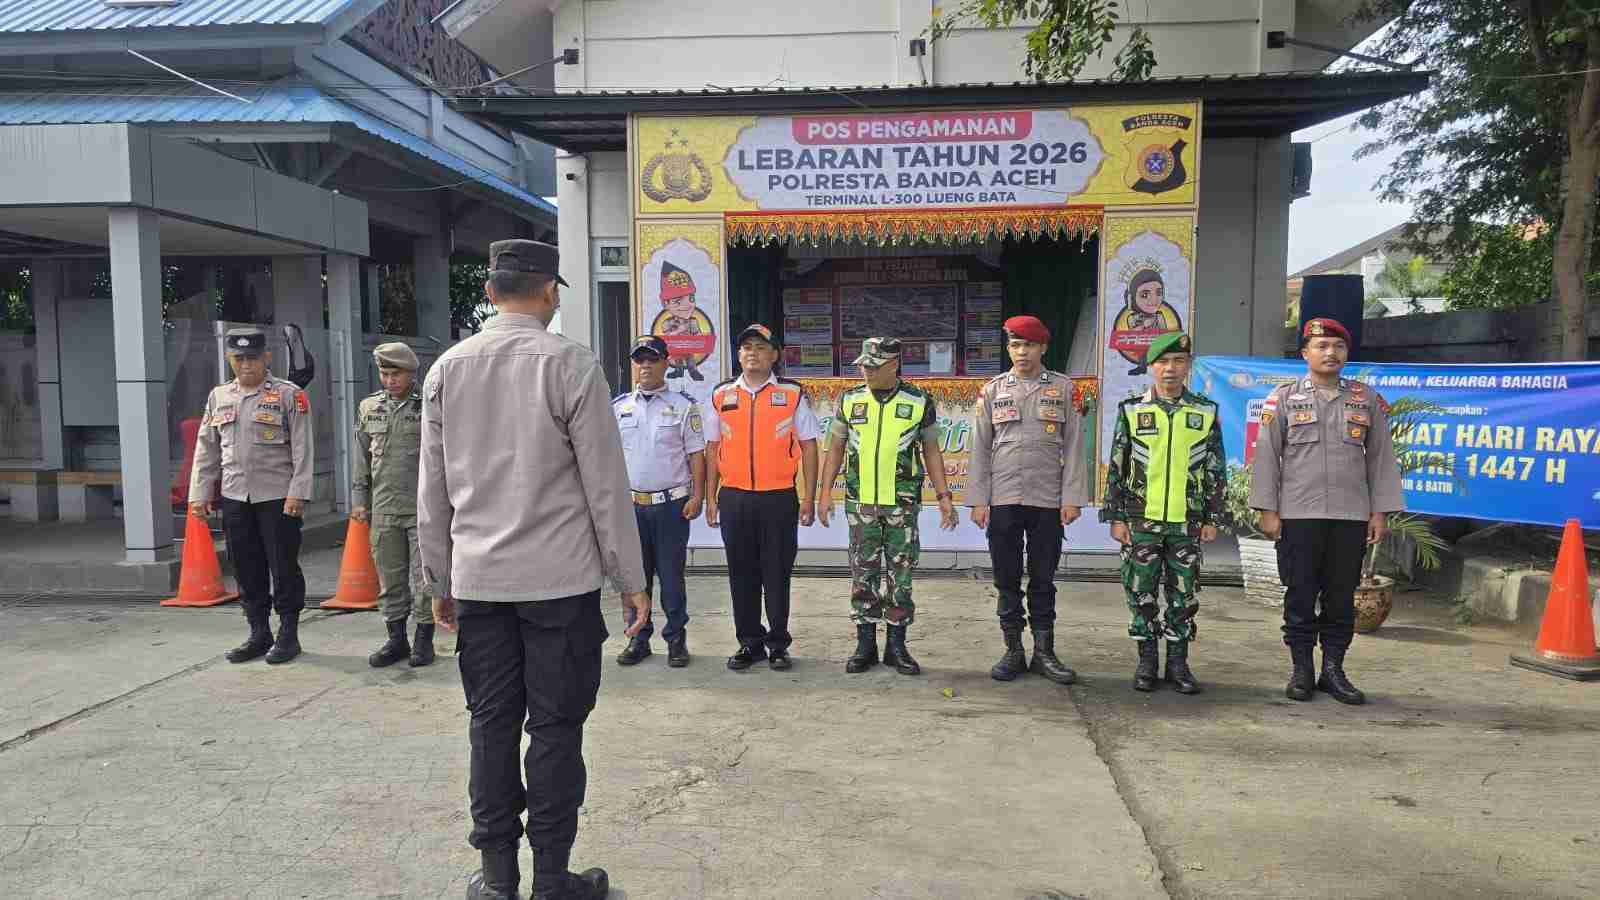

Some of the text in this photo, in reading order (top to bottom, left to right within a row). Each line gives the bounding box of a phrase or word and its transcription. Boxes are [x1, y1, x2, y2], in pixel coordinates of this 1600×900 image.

[807, 117, 1016, 140] POS PENGAMANAN
[738, 141, 1088, 171] LEBARAN TAHUN 2026
[768, 168, 1057, 191] POLRESTA BANDA ACEH
[806, 191, 1017, 206] TERMINAL L-300 LUENG BATA
[1379, 374, 1422, 388] AMAN,
[1425, 374, 1497, 388] KELUARGA
[1501, 375, 1569, 390] BAHAGIA
[1456, 424, 1525, 450] HARI
[1465, 453, 1536, 481] 1447
[1545, 458, 1567, 484] H
[1425, 480, 1454, 495] BATIN
